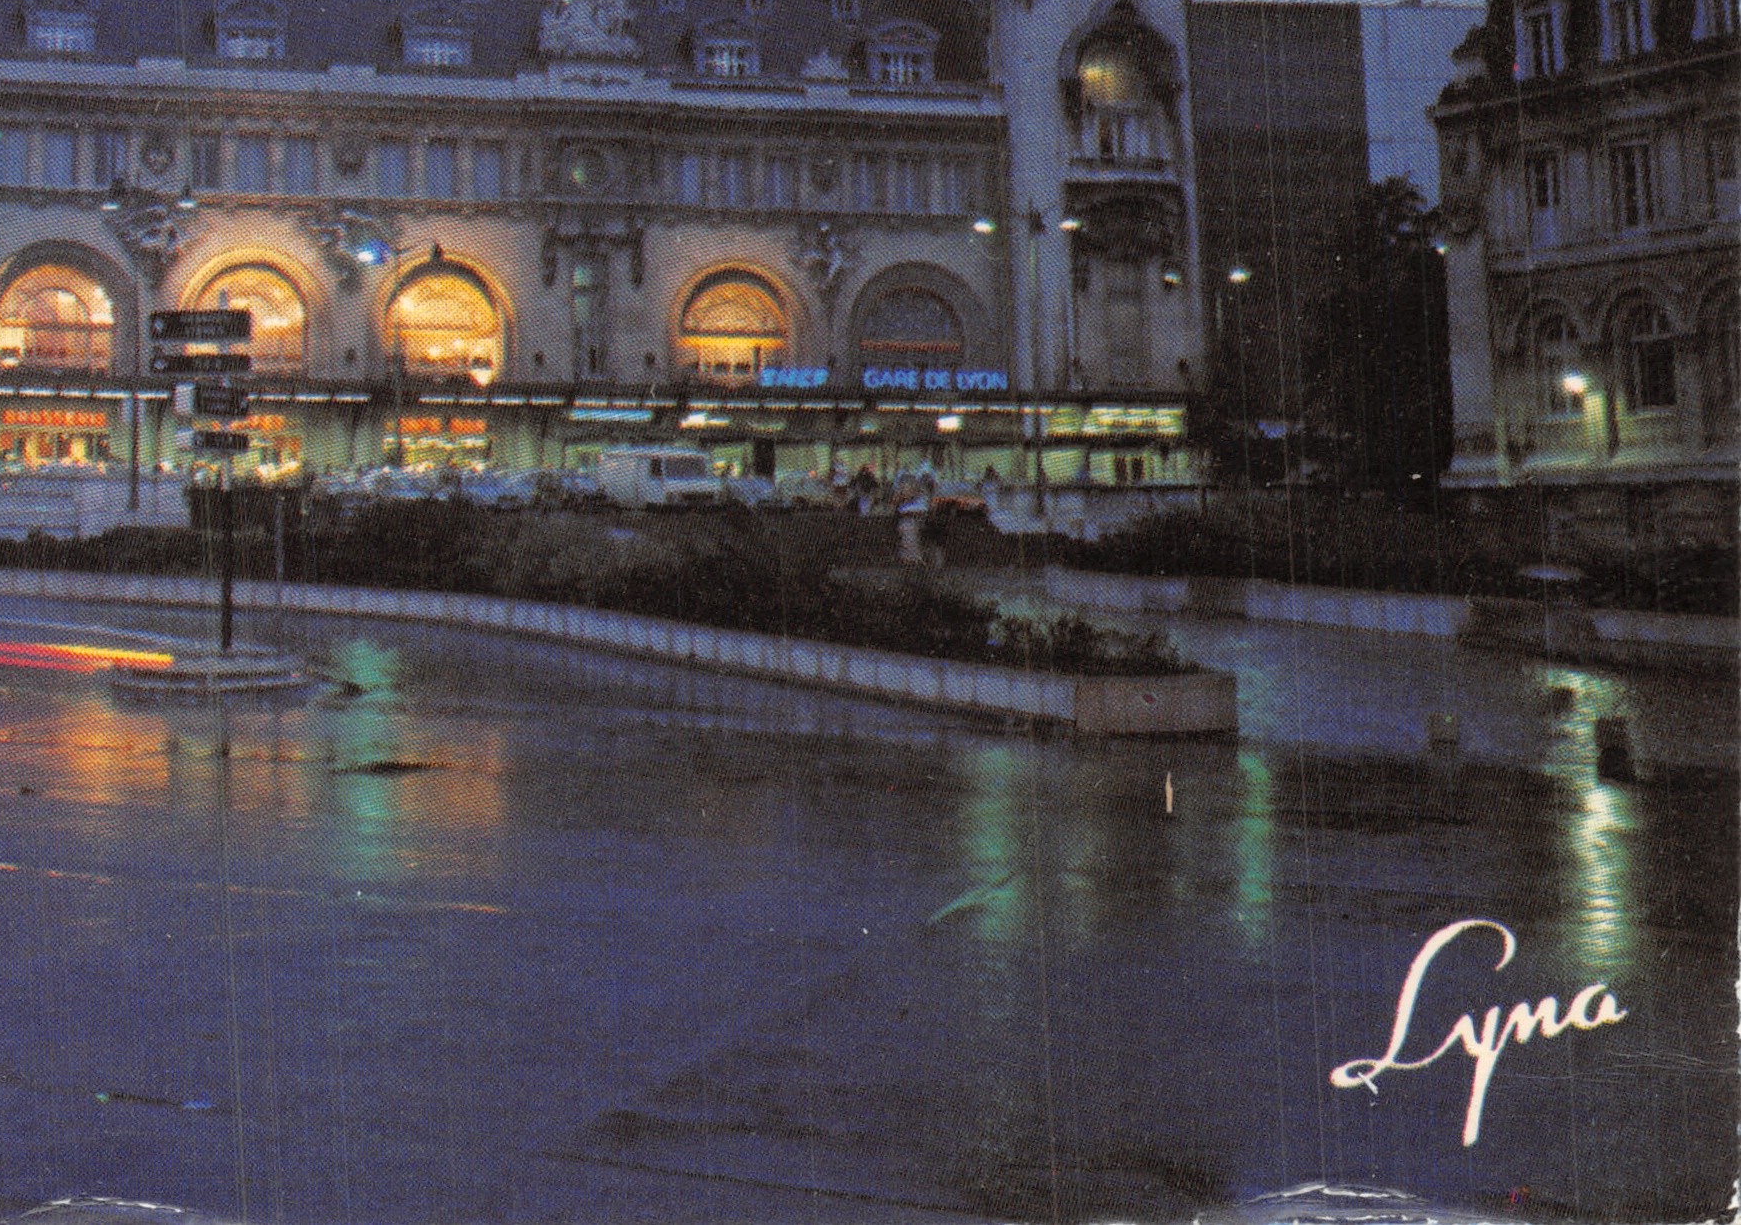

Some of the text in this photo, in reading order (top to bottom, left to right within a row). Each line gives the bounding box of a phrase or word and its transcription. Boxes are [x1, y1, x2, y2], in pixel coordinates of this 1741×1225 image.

[861, 366, 1009, 391] GARE DE LYON
